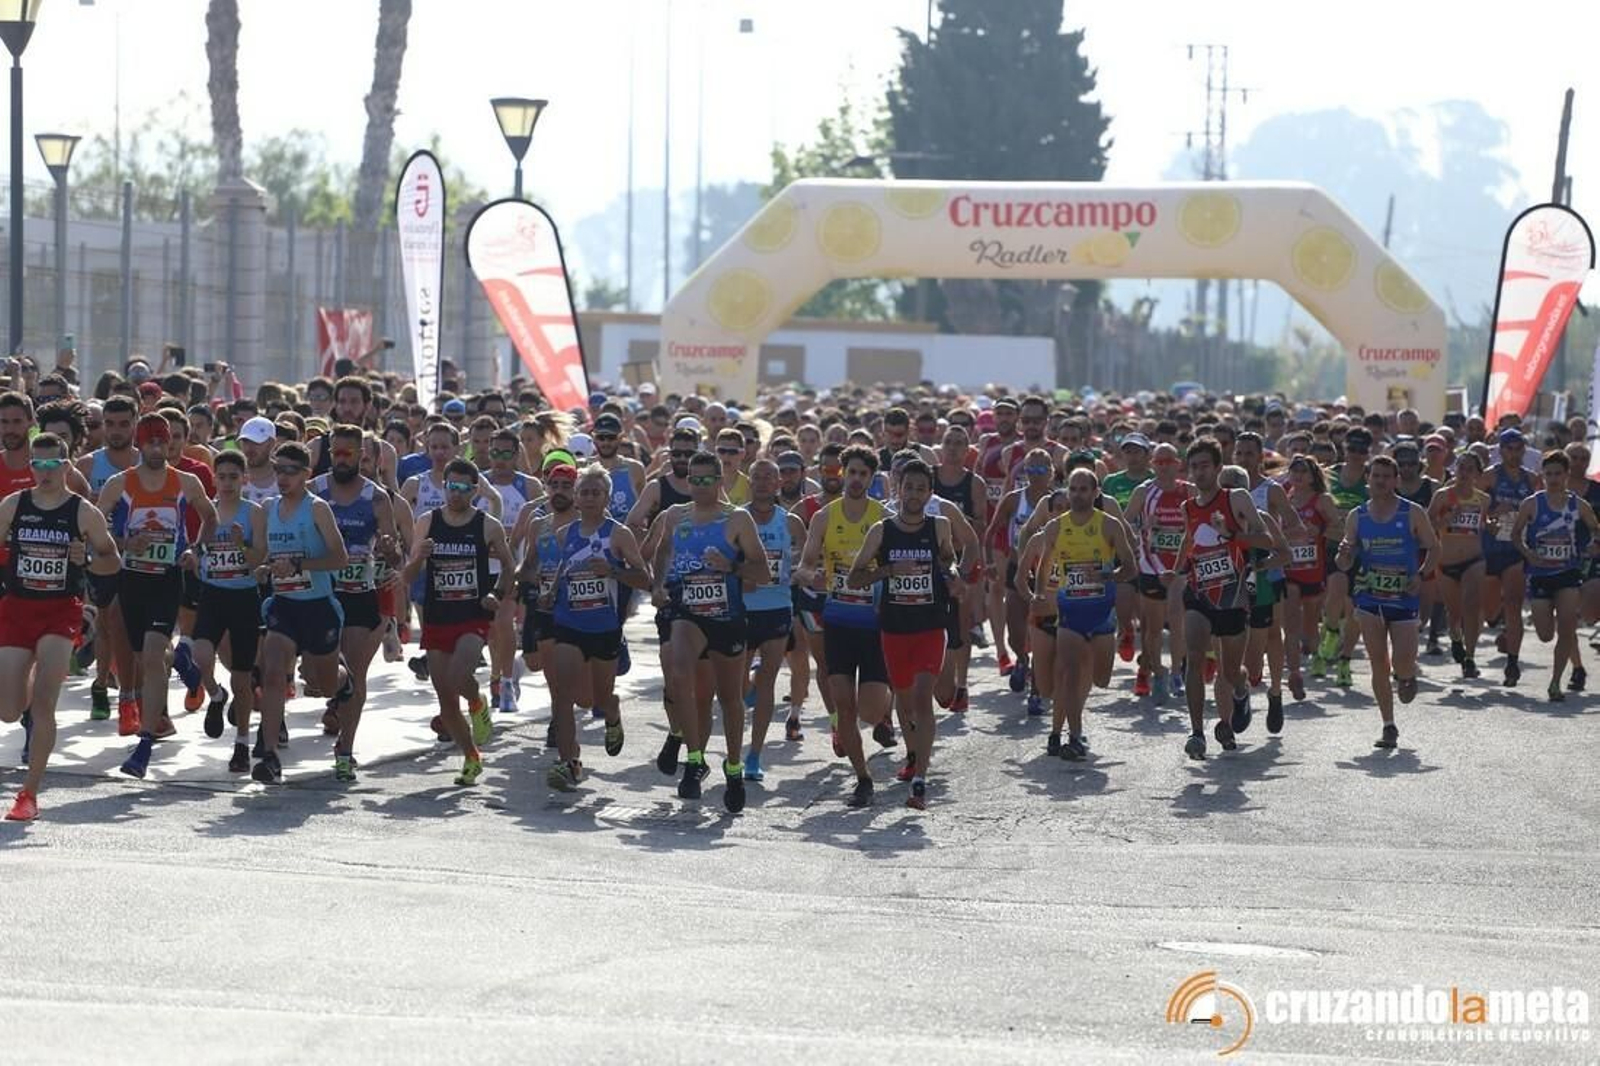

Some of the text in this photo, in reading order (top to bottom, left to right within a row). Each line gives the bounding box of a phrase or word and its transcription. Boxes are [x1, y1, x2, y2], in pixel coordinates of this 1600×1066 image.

[949, 194, 1157, 232] Cruzcampo
[969, 240, 1069, 268] Radler
[1359, 344, 1440, 362] Cruzcampo
[18, 527, 70, 543] GRANADA
[210, 552, 246, 567] 3148
[889, 549, 932, 559] GRANADA
[22, 559, 64, 575] 3068
[1199, 558, 1230, 577] 3035
[440, 572, 474, 587] 3070
[894, 576, 929, 591] 3060
[1375, 576, 1402, 588] 124
[570, 580, 605, 596] 3050
[688, 585, 723, 600] 3003
